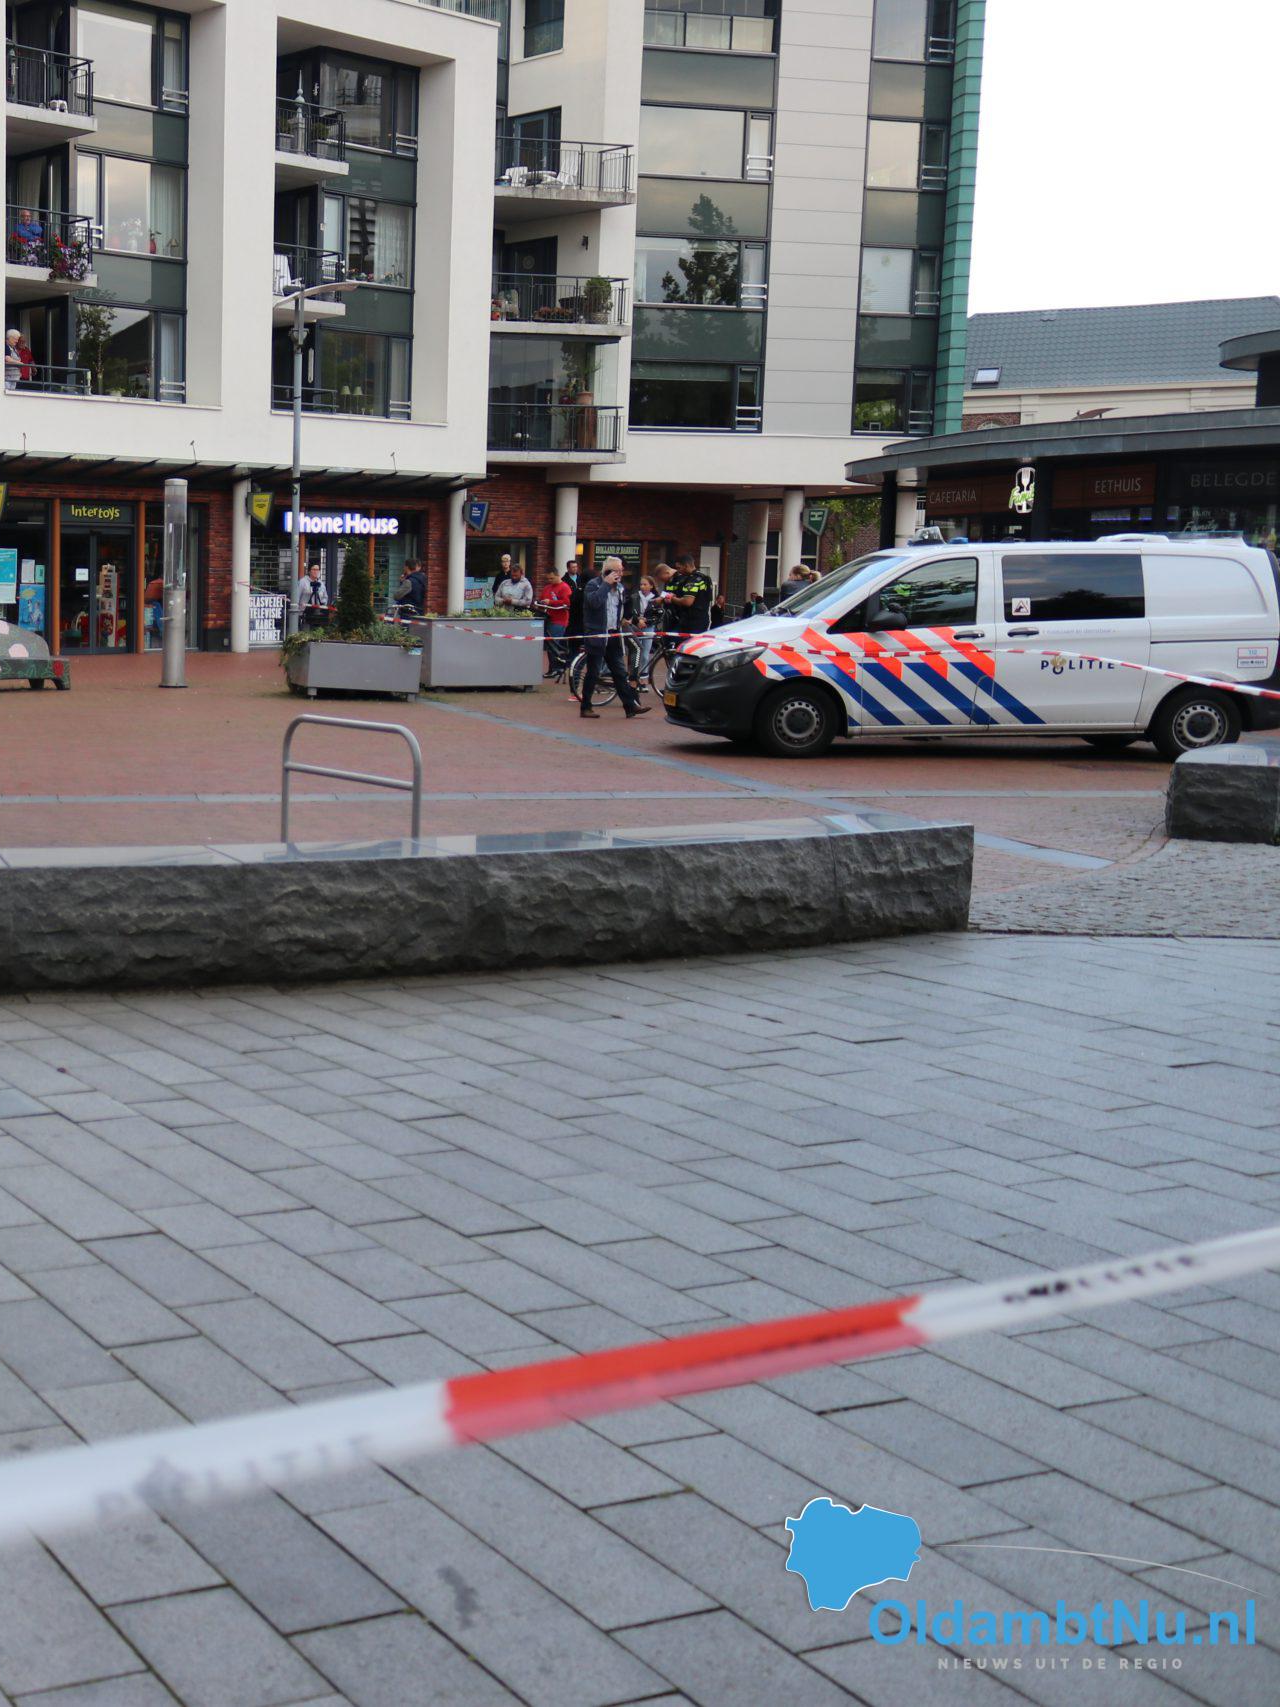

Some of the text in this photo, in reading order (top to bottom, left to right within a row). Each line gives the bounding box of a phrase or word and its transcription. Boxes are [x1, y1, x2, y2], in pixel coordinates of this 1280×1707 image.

[1094, 477, 1143, 494] EETHUIS
[1190, 471, 1278, 488] BELEGDE
[929, 489, 977, 505] CAFETARIA
[71, 504, 120, 521] Intertoys
[344, 512, 399, 535] House
[250, 607, 282, 619] TELEVISIE
[255, 618, 276, 630] KABEL
[250, 629, 281, 641] INTERNET
[1040, 657, 1116, 675] POLITIE
